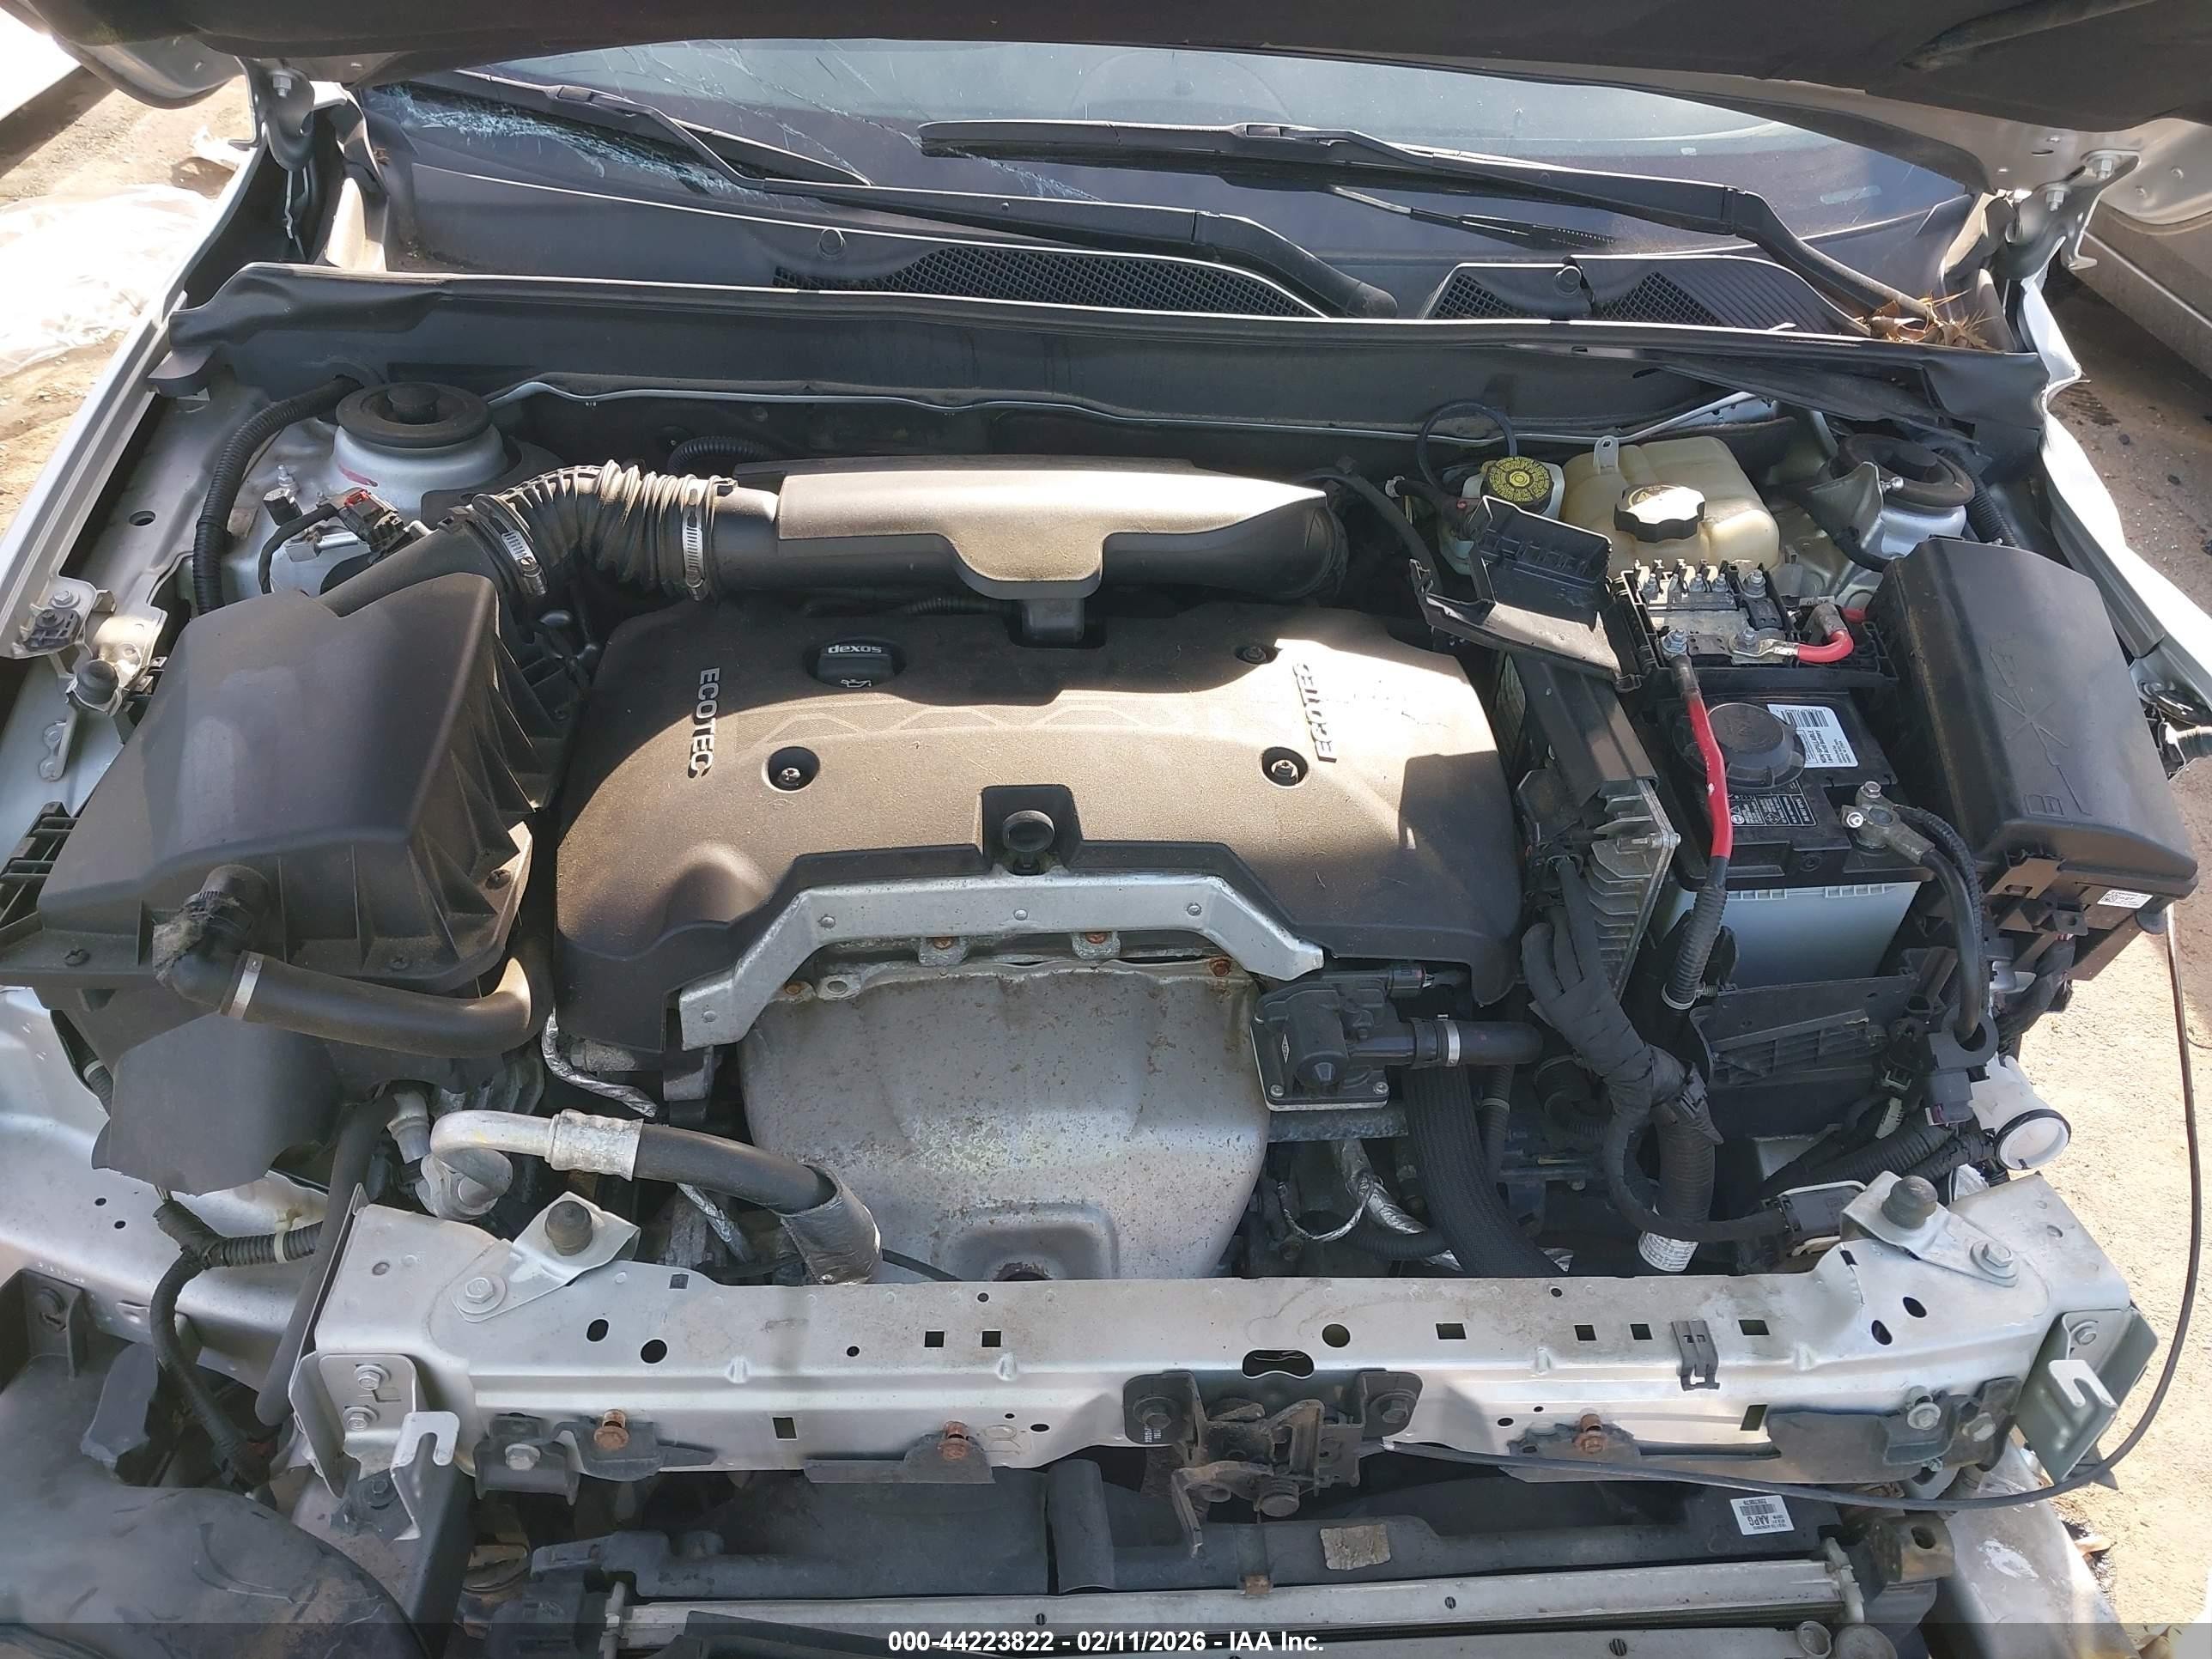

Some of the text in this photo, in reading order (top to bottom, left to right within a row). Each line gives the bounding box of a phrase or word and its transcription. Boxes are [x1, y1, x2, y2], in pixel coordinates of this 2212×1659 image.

[828, 644, 882, 653] dexos
[689, 667, 720, 778] ECOTEC
[1747, 1515, 1770, 1526] AAPG
